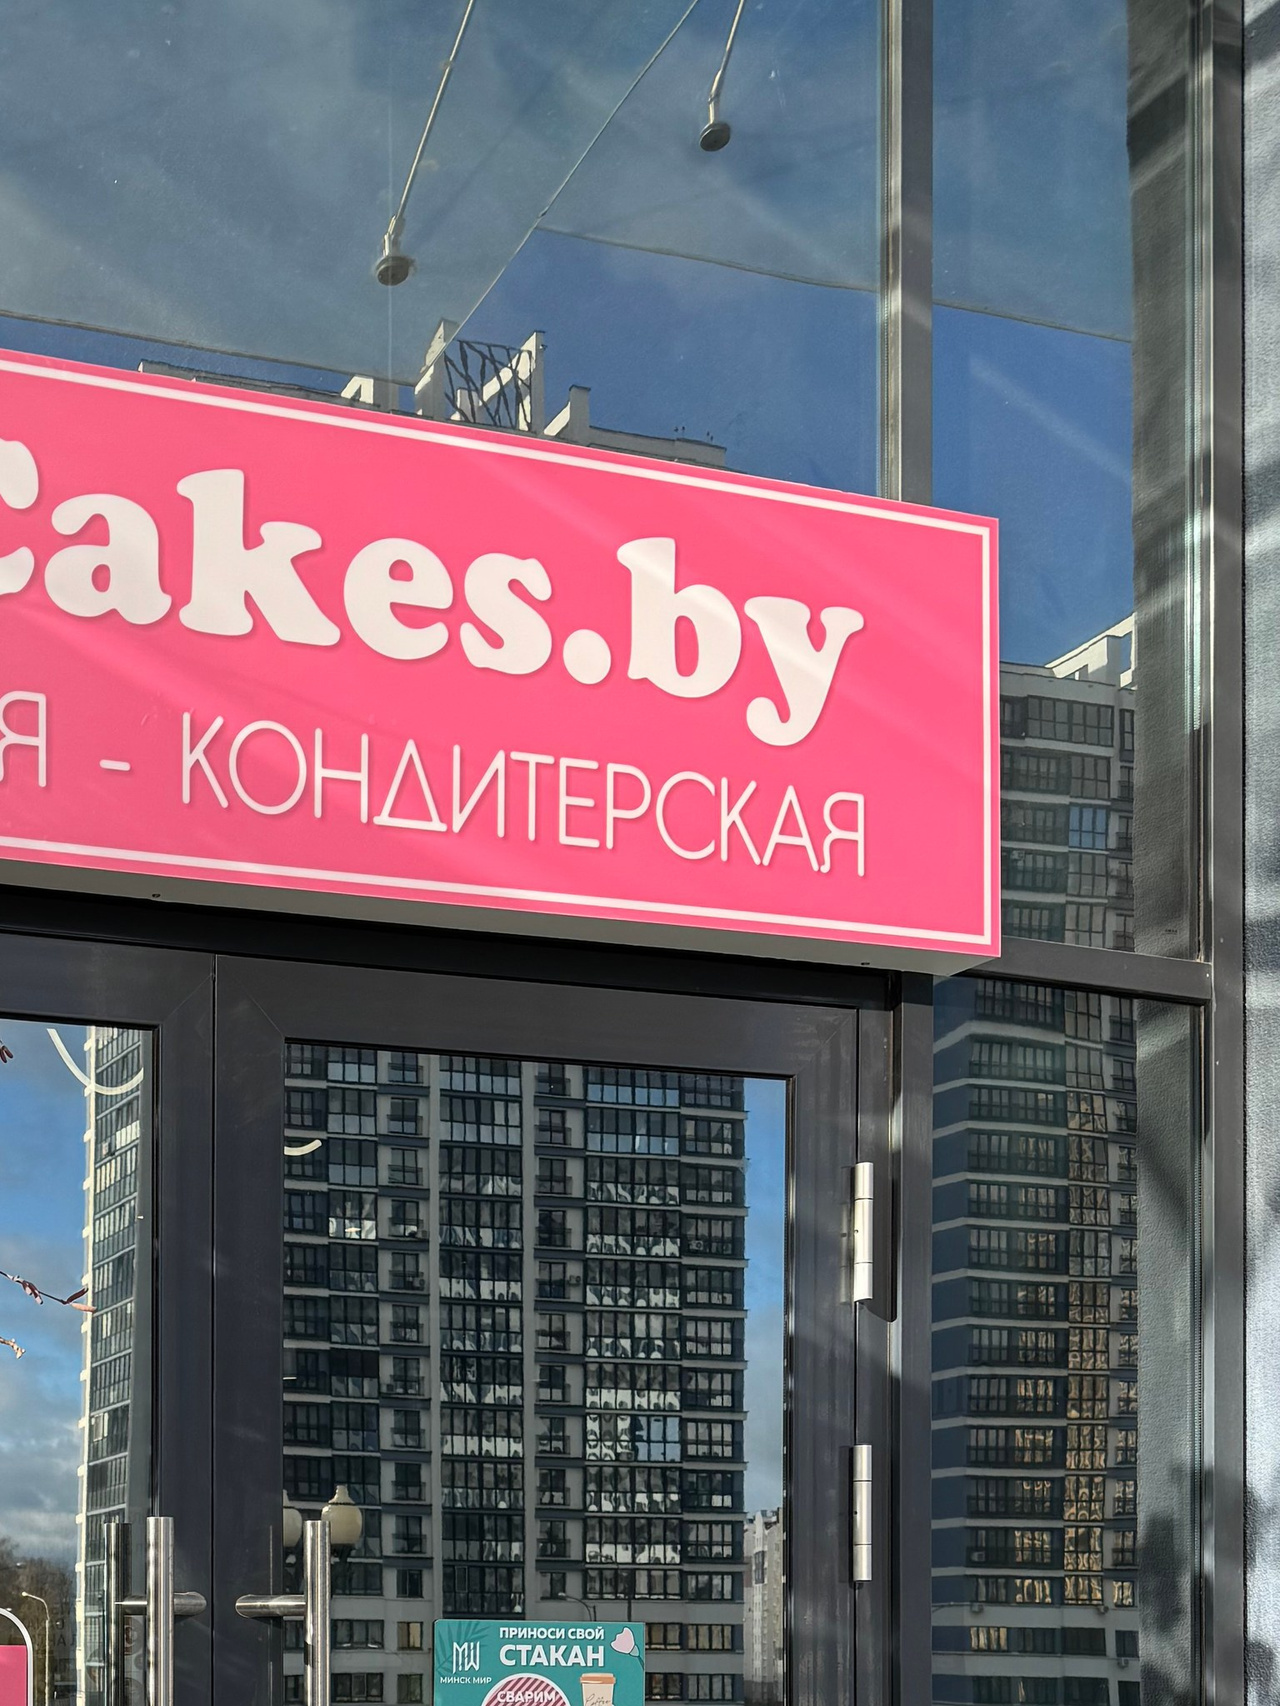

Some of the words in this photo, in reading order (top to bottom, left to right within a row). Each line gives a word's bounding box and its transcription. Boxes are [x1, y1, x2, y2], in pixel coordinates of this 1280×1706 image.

[181, 711, 867, 877] КОНДИТЕРСКАЯ
[499, 1627, 565, 1640] ПРИНОСИ
[568, 1626, 605, 1640] СВОЙ
[499, 1645, 605, 1667] СТАКАН
[440, 1676, 471, 1684] МИНСК
[472, 1676, 492, 1684] МИР
[496, 1690, 556, 1704] СВАРИМ
